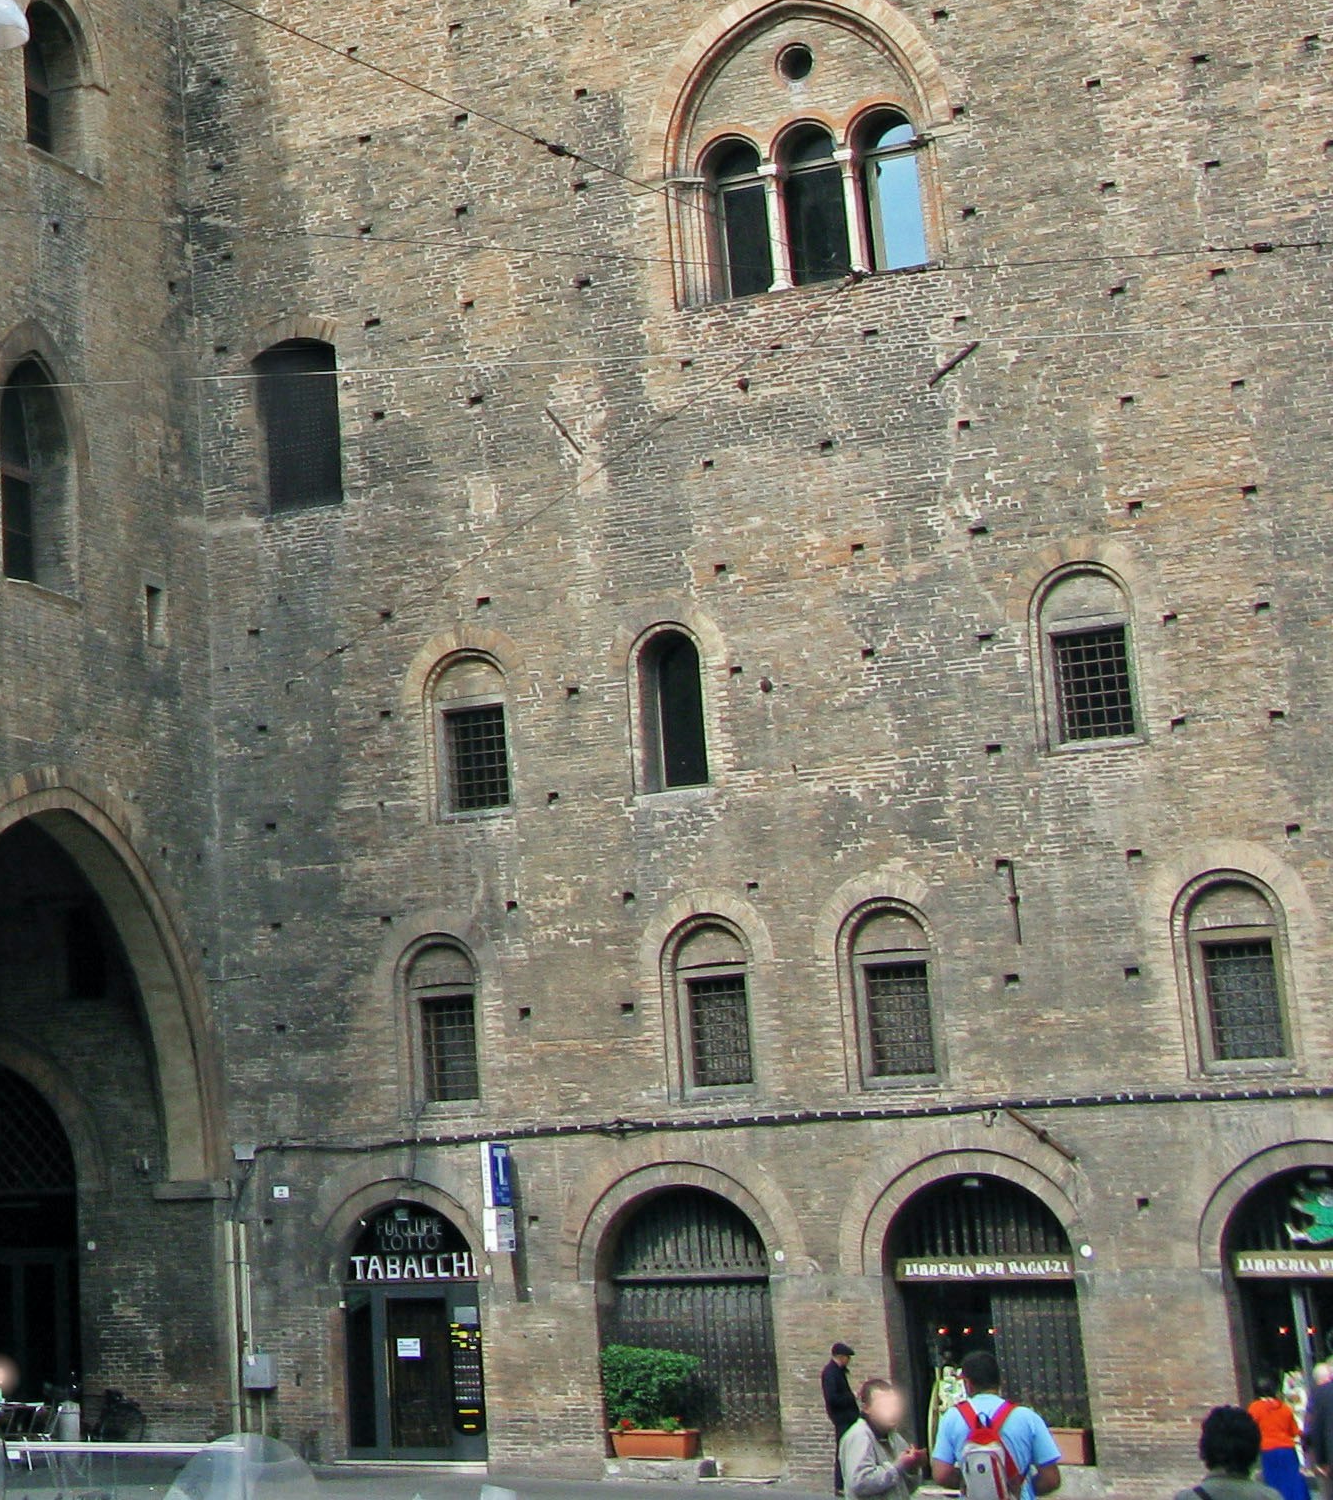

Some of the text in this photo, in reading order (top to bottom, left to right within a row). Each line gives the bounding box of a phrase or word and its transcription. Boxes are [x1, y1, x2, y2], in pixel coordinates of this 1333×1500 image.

[381, 1234, 439, 1251] LOTTO
[351, 1252, 478, 1280] TABACCHI
[904, 1259, 1070, 1278] LIBRERIA PER RAGAZZI
[1238, 1258, 1318, 1274] LIBRERIA
